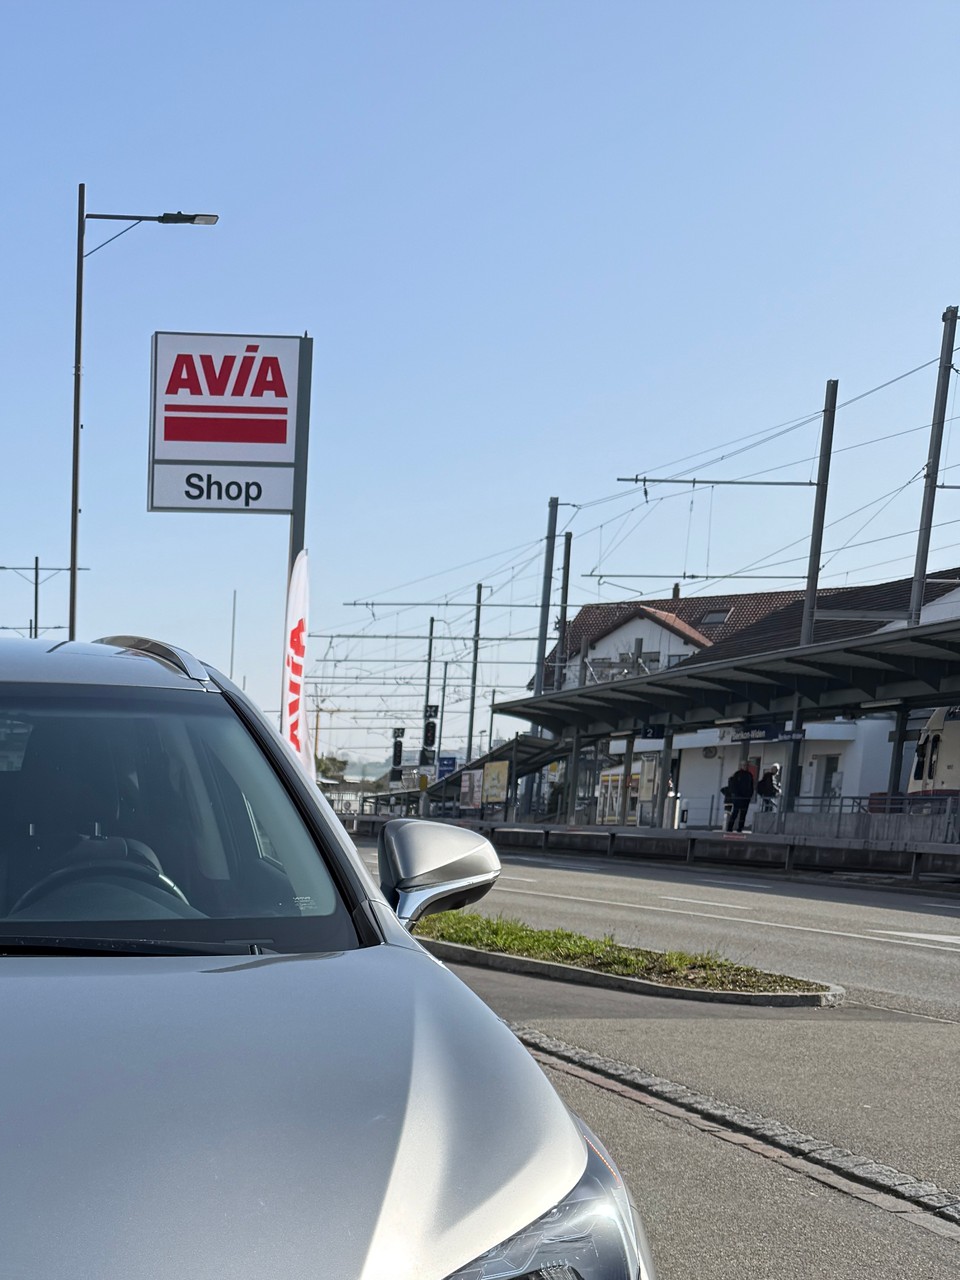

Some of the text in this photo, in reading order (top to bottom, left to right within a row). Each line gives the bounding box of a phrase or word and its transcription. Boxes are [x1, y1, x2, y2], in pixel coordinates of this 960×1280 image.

[165, 344, 288, 398] AVIA
[184, 473, 263, 508] Shop
[286, 617, 307, 753] AVIA
